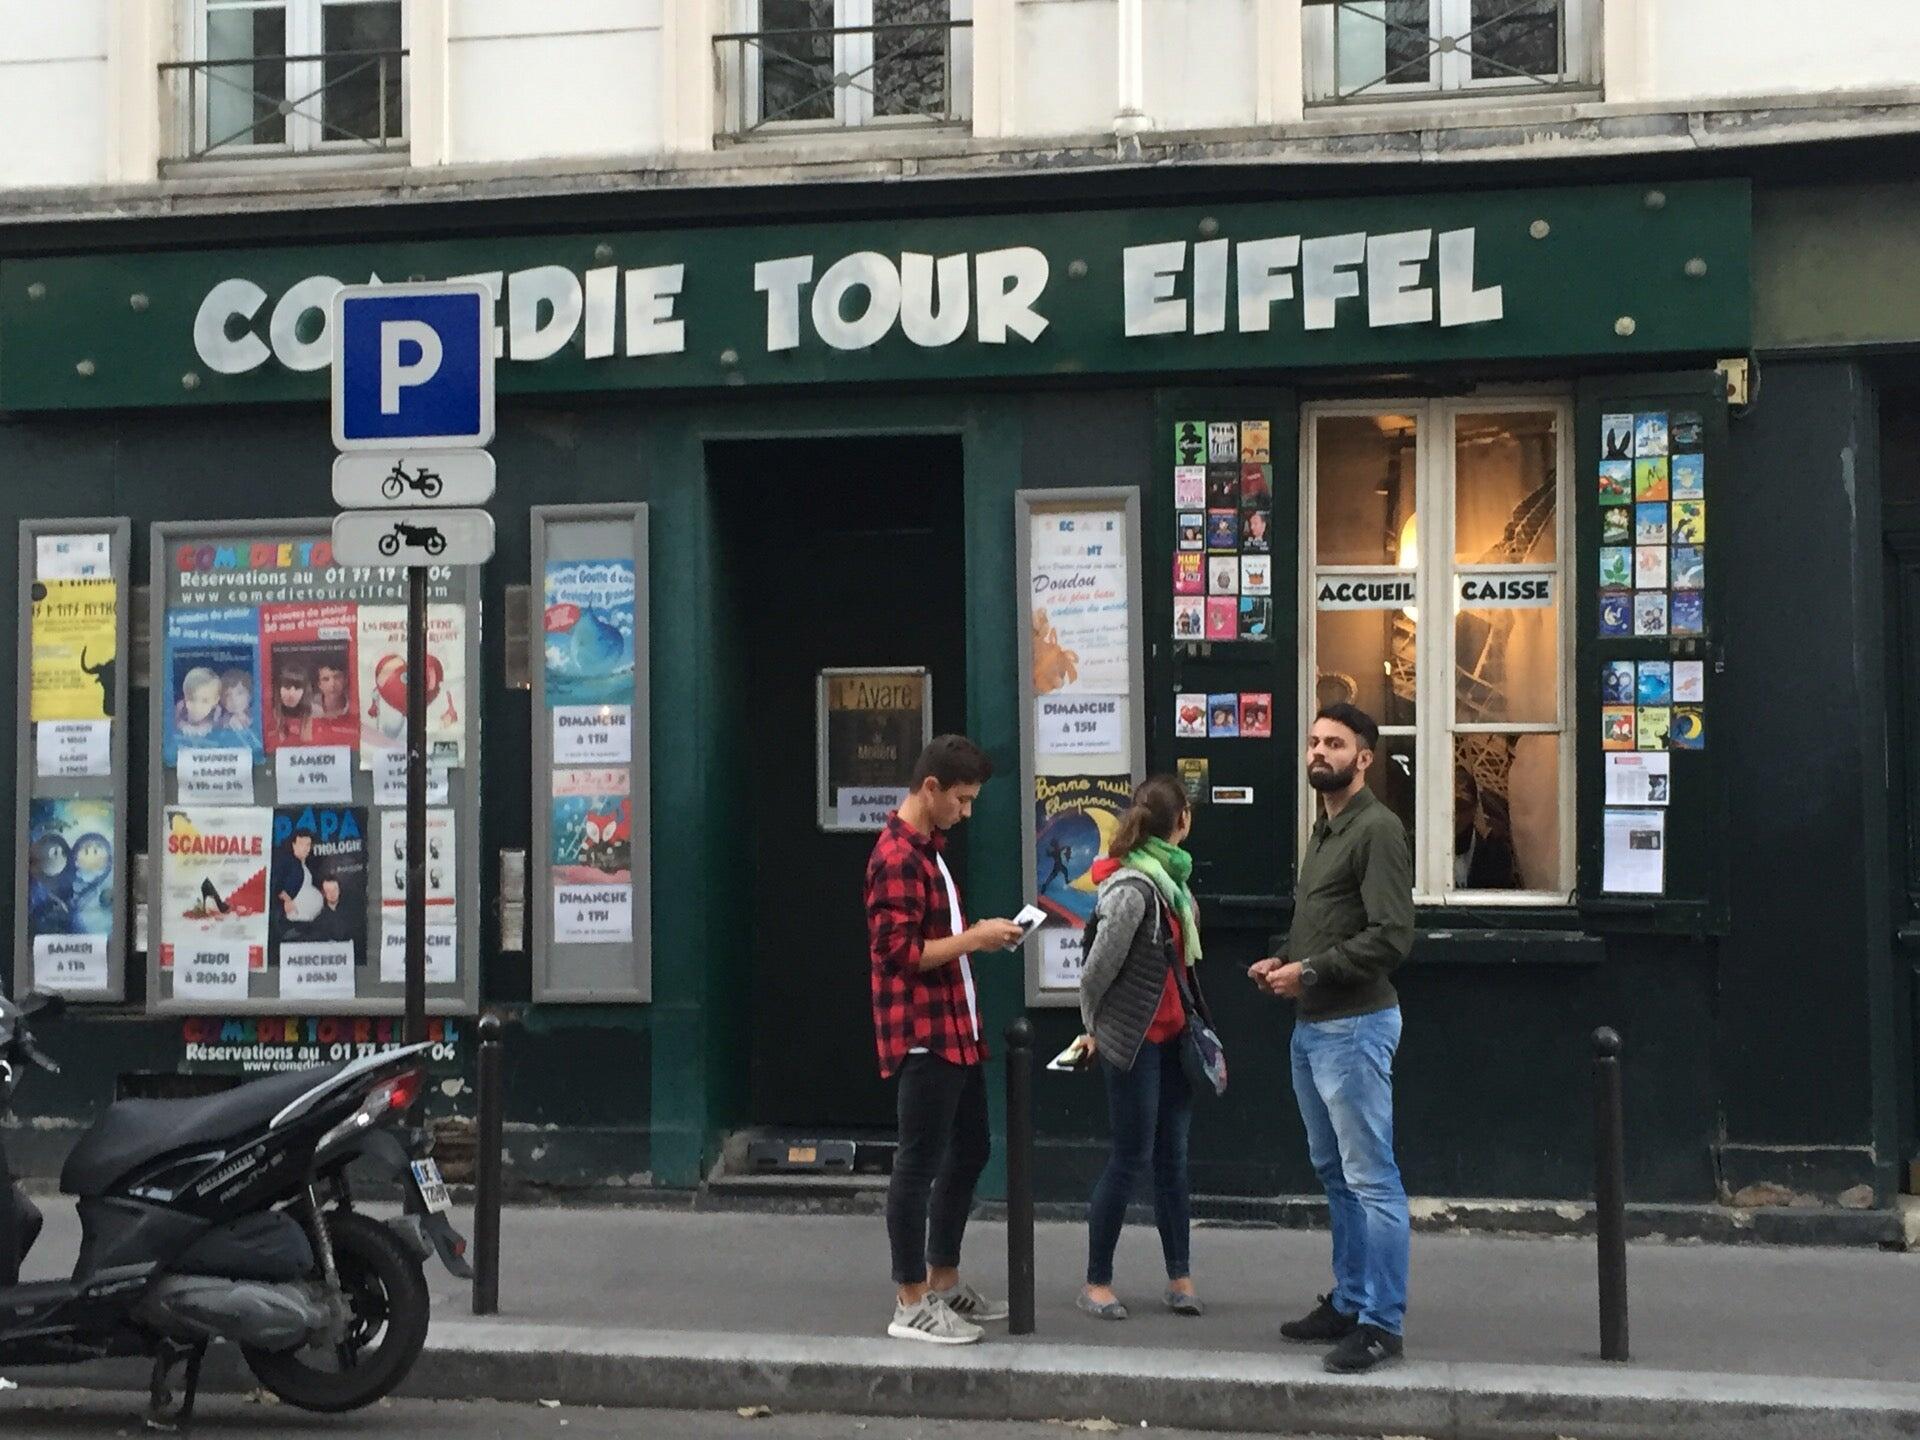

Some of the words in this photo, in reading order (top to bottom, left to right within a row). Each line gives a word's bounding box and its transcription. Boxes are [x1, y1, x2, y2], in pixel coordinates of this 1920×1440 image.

[193, 263, 685, 374] CODIE
[754, 246, 1050, 352] TOUR
[1123, 227, 1503, 337] EIFFEL
[381, 320, 443, 415] P
[180, 568, 287, 587] Réservations
[293, 571, 313, 585] au
[325, 567, 345, 583] 01
[352, 567, 370, 582] 77
[378, 566, 395, 582] 17
[429, 565, 451, 581] 04
[1032, 573, 1097, 594] Doudou
[1318, 582, 1415, 602] ACCUEIL
[1461, 580, 1549, 600] CAISSE
[1044, 702, 1115, 715] DIMANCHE
[559, 715, 626, 727] DIMANCHE
[1062, 723, 1070, 733] à
[289, 754, 335, 766] SAMEDI
[1035, 778, 1091, 800] Bonne
[1096, 780, 1132, 798] nuit
[851, 794, 897, 806] SAMEDI
[274, 805, 360, 847] PAPA
[169, 833, 262, 855] SCANDALE
[559, 892, 627, 904] DIMANCHE
[194, 952, 229, 965] JEUDI
[287, 953, 347, 966] MERCREDI
[196, 971, 237, 984] 20h30
[186, 1042, 294, 1060] Réservations
[298, 1045, 320, 1060] au
[330, 1043, 351, 1060] 01
[431, 1042, 455, 1060] 04
